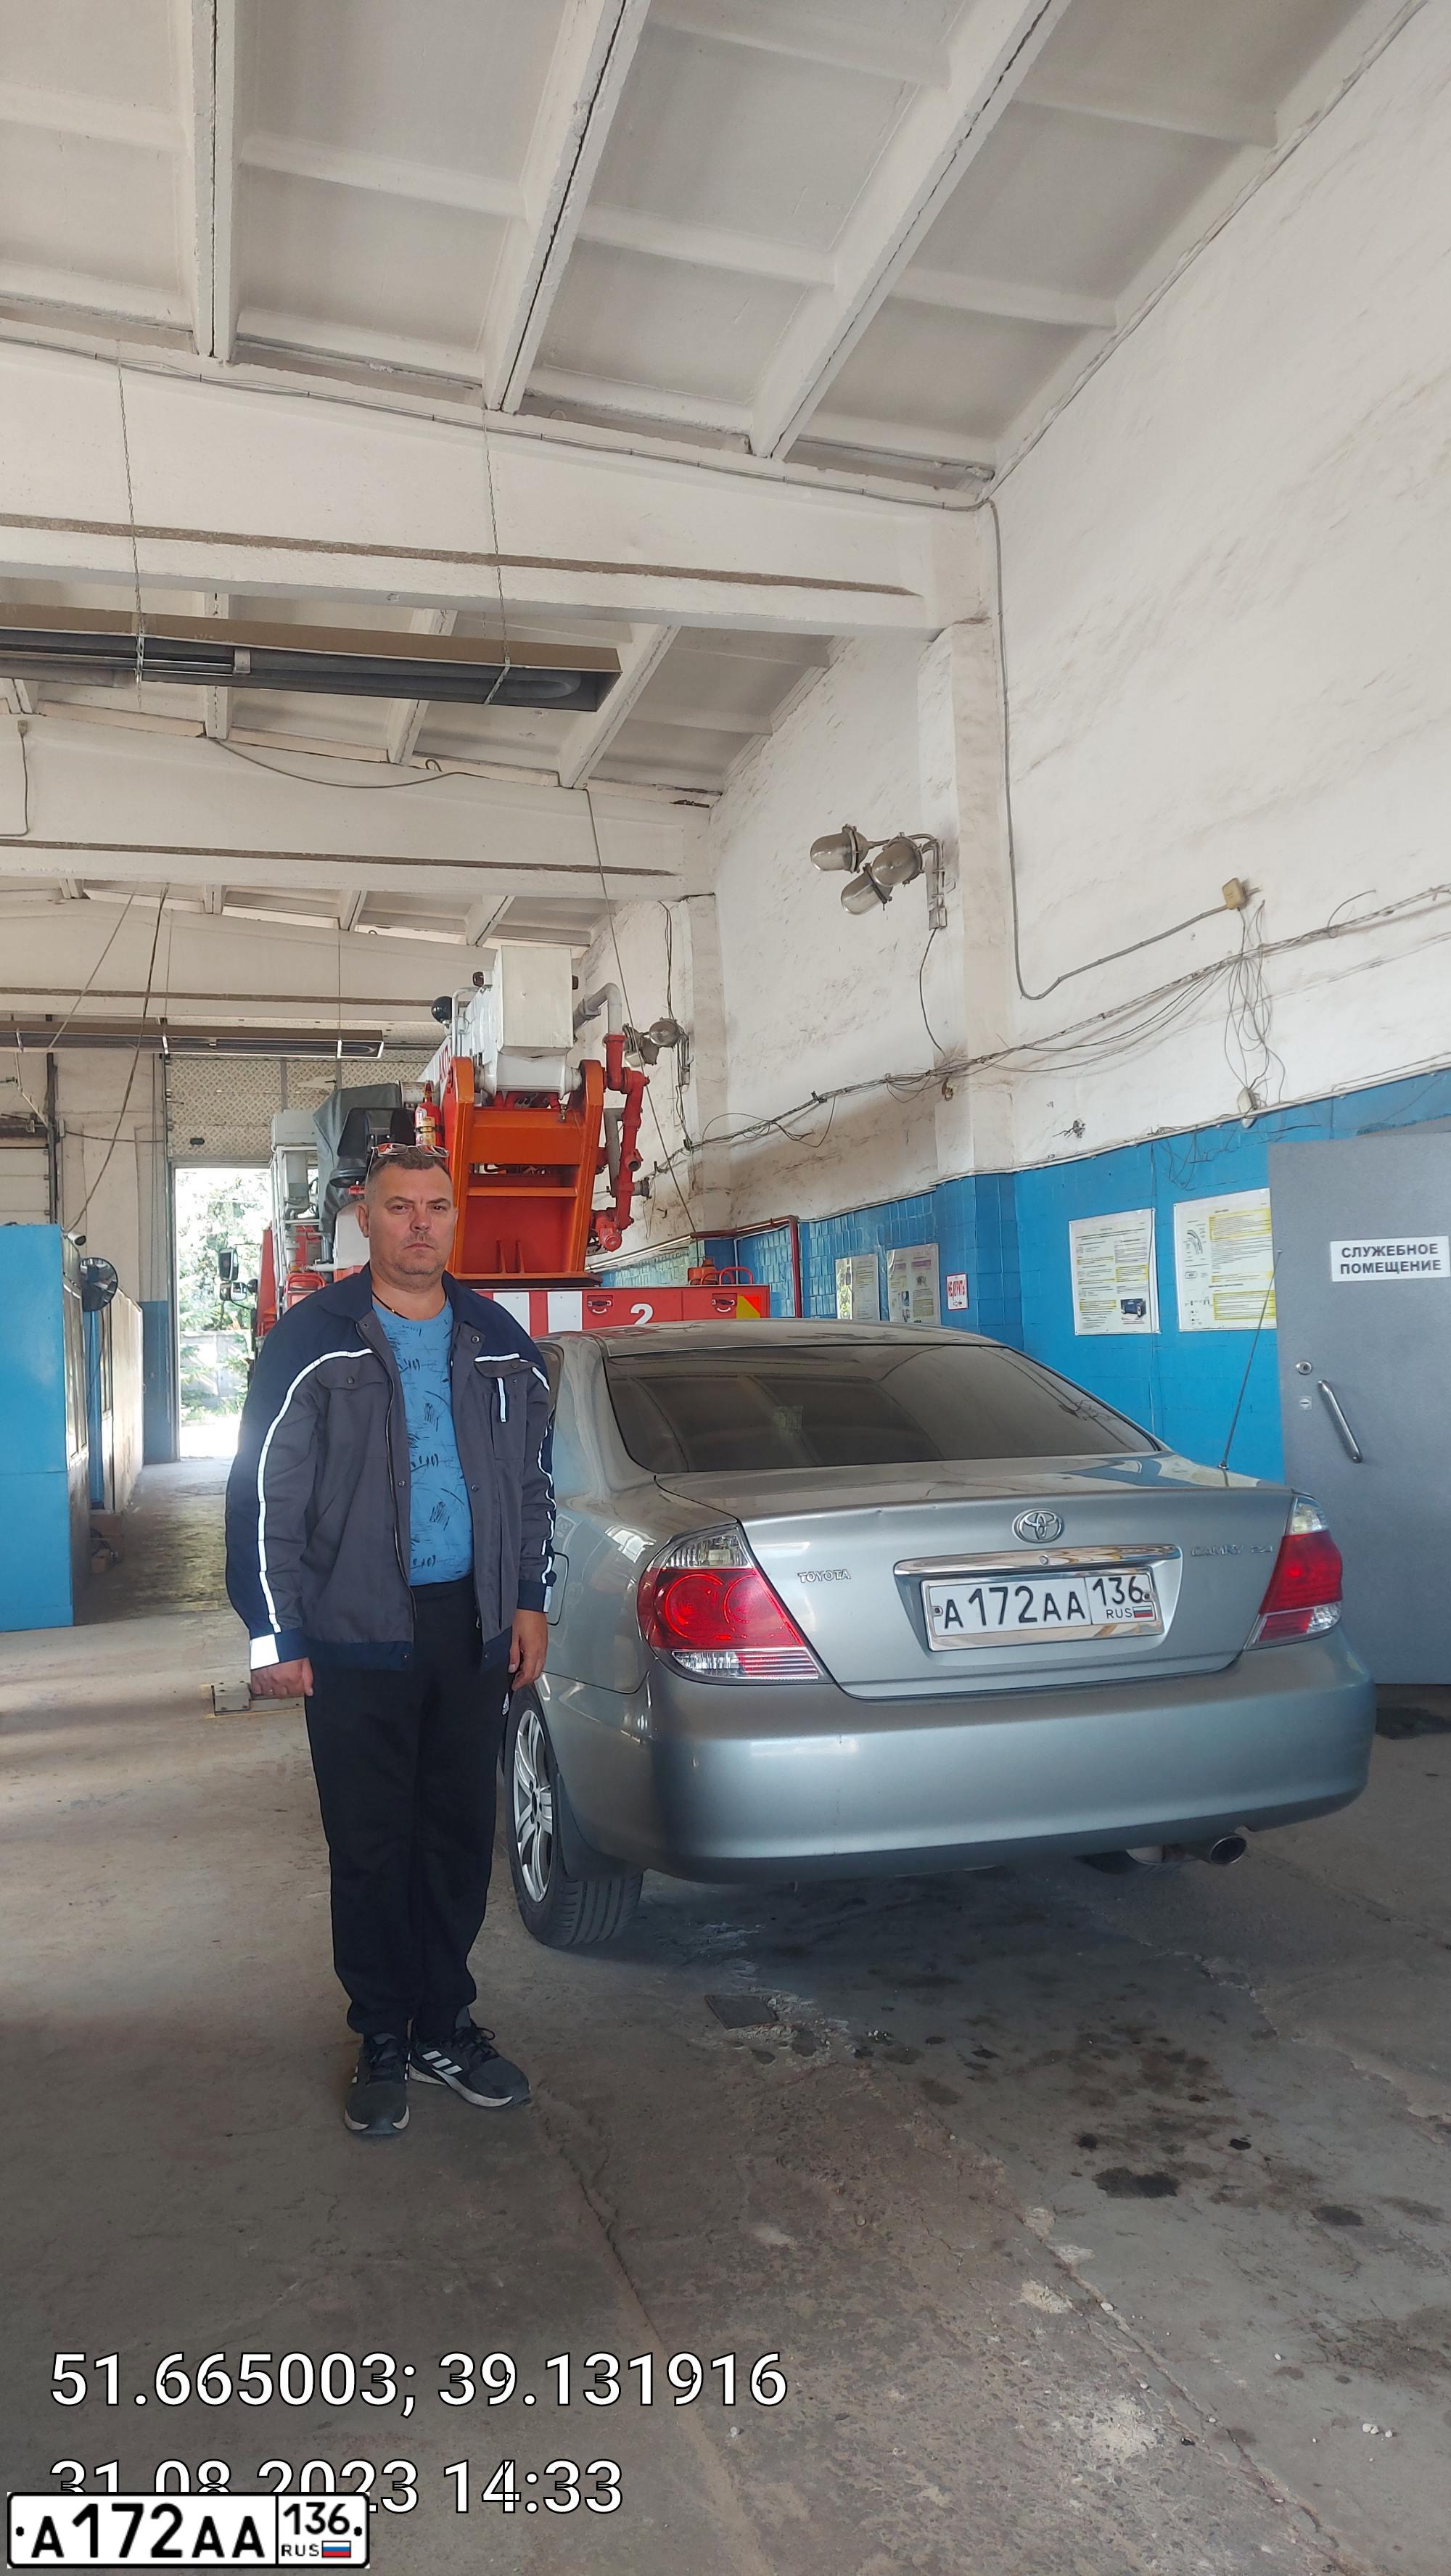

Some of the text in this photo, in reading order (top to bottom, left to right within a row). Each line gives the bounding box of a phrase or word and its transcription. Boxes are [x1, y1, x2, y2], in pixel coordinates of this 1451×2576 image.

[1341, 1243, 1439, 1258] СЛУЖЕБНОЕ
[1340, 1259, 1442, 1274] ПОМЕЩЕНИЕ
[630, 1303, 654, 1325] 2
[797, 1568, 851, 1583] TOYOTA
[944, 1576, 1144, 1629] А172АА 136
[1106, 1608, 1133, 1619] RUS
